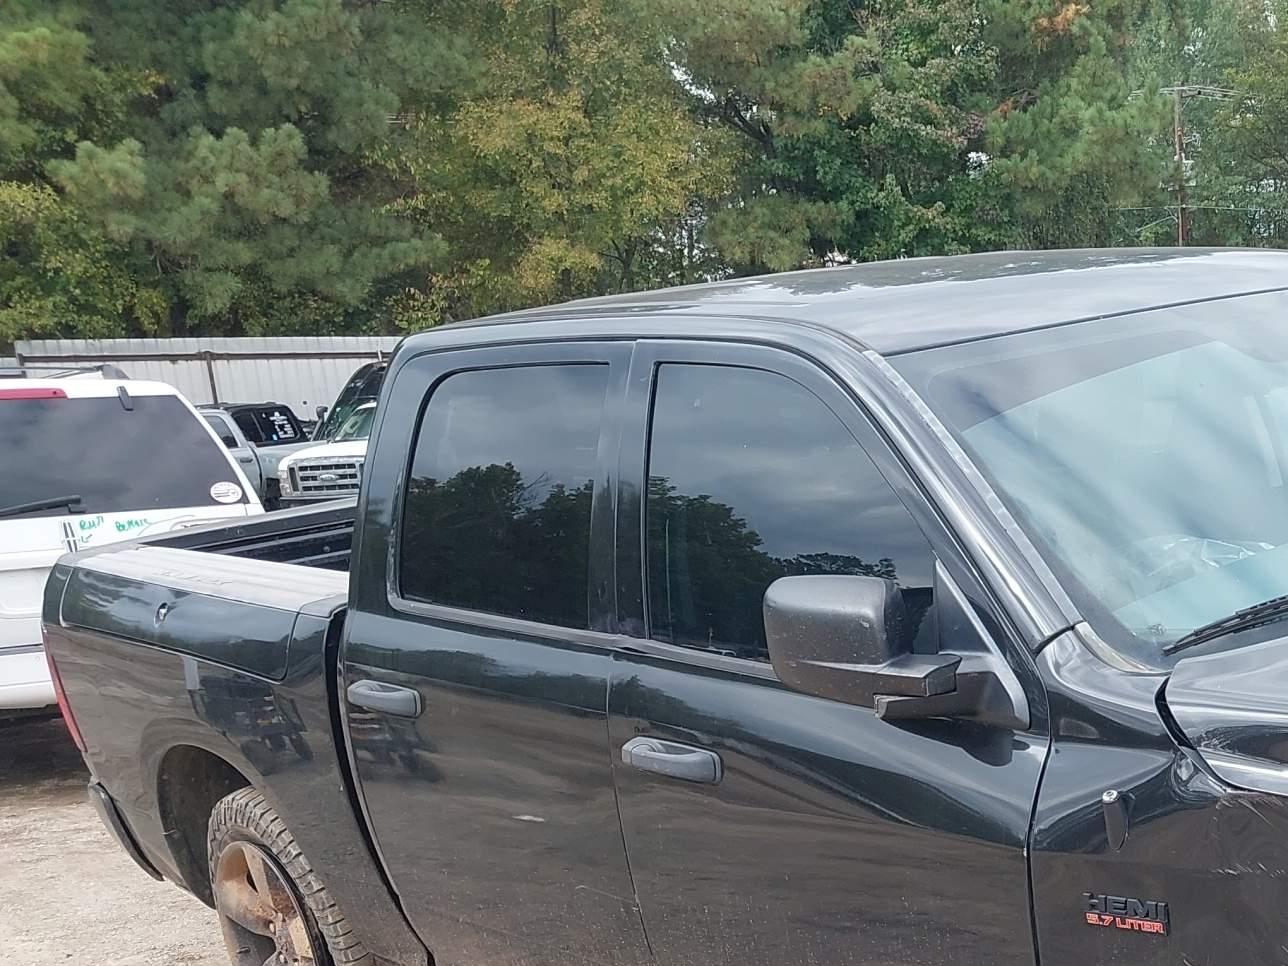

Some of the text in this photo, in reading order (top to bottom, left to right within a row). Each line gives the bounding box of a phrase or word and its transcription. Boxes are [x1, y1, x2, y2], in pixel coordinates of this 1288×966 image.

[1082, 892, 1168, 922] HEMI
[1086, 913, 1164, 934] 5.7 LITER
